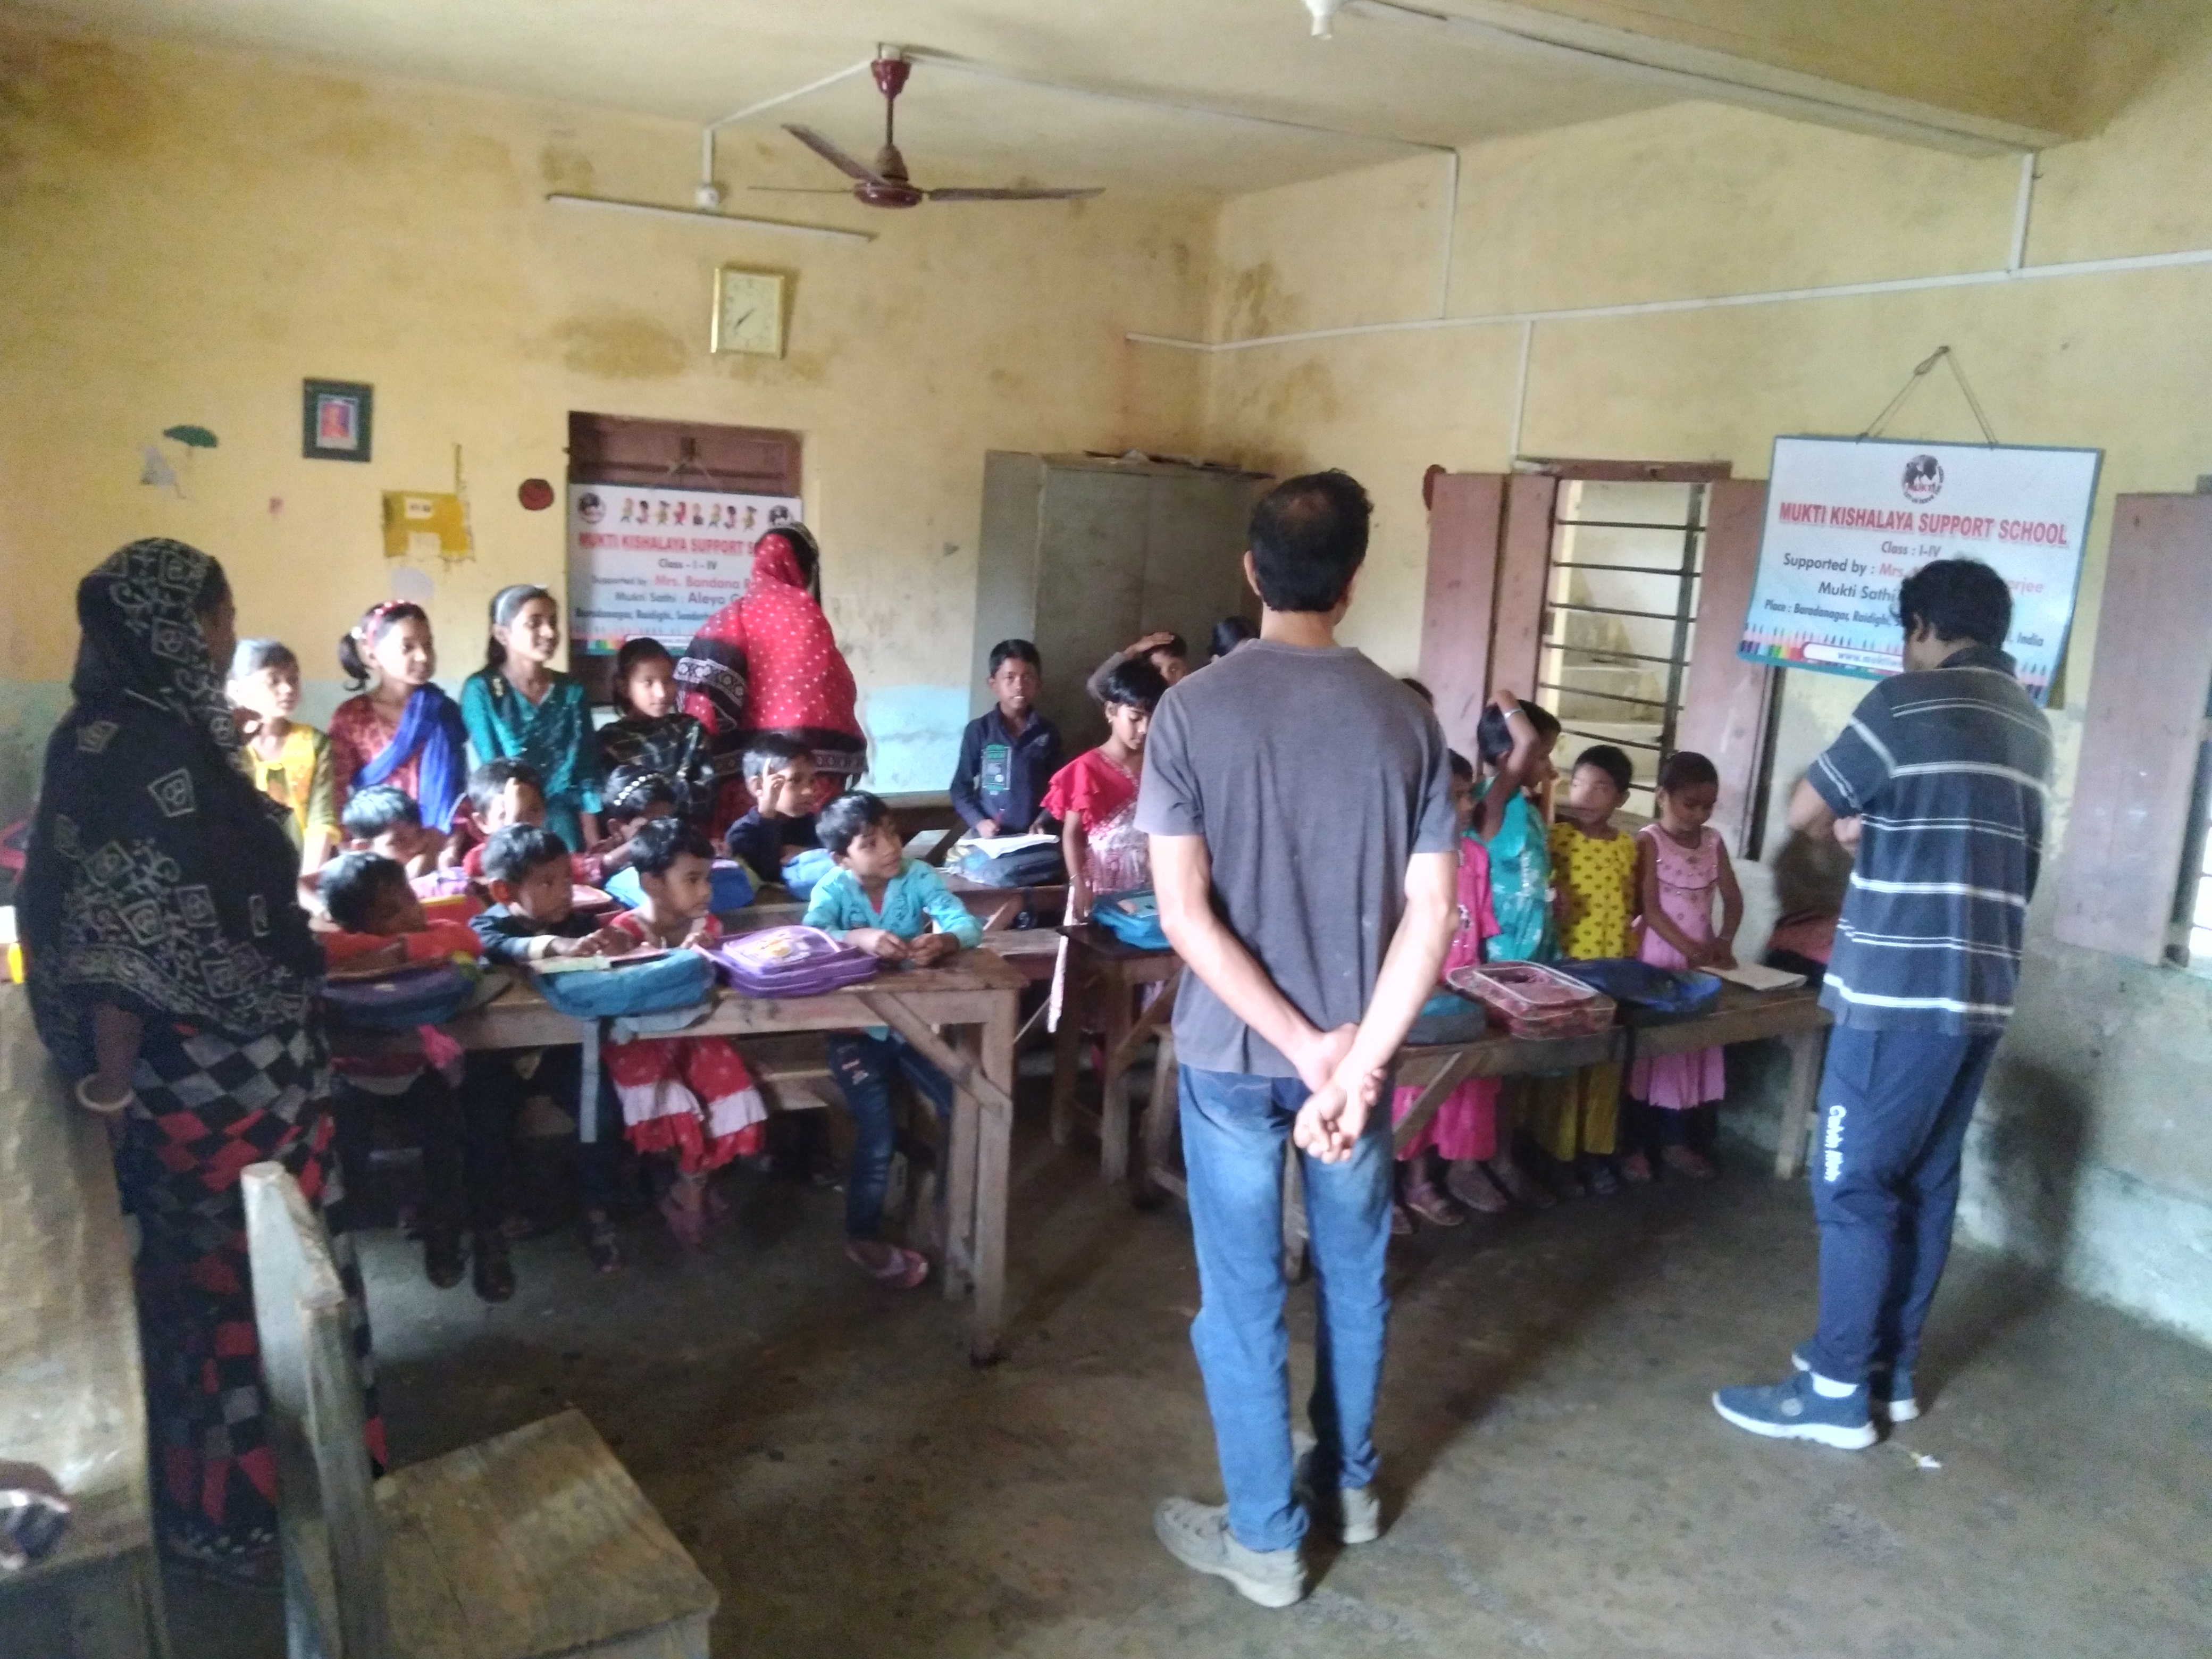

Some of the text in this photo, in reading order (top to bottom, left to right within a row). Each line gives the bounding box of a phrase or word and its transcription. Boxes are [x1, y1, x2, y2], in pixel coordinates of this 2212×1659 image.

[1780, 502, 2067, 546] MUKTI KISHALAYA SUPPORT SCHOOL
[622, 535, 686, 551] KISHALAYA
[691, 538, 743, 555] SUPPORT
[1881, 540, 1908, 555] Class
[1919, 544, 1941, 557] I-IV
[1783, 552, 1848, 572] Supported
[1851, 559, 1867, 577] by
[1818, 582, 1897, 602] Mukti Sathi
[1765, 599, 1786, 613] Place
